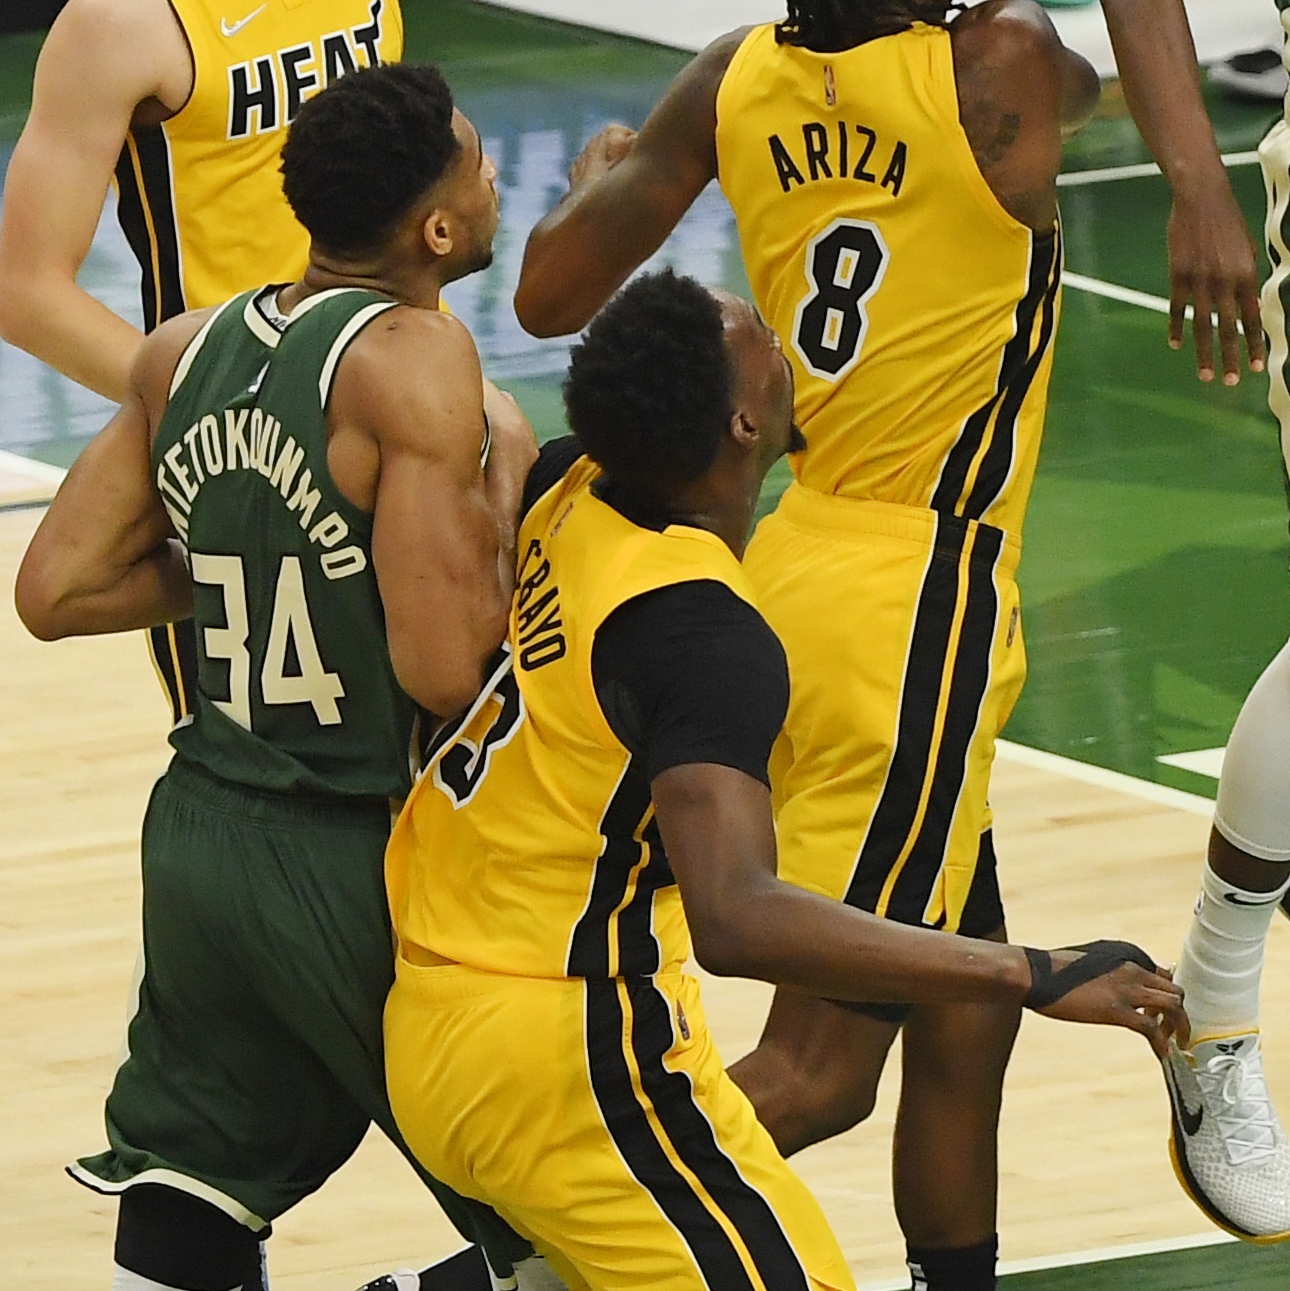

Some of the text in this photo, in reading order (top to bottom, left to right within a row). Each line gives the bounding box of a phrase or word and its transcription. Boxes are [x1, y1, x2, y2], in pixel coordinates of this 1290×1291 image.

[768, 120, 908, 198] ARIZA
[790, 217, 891, 384] 8
[191, 552, 346, 733] 34
